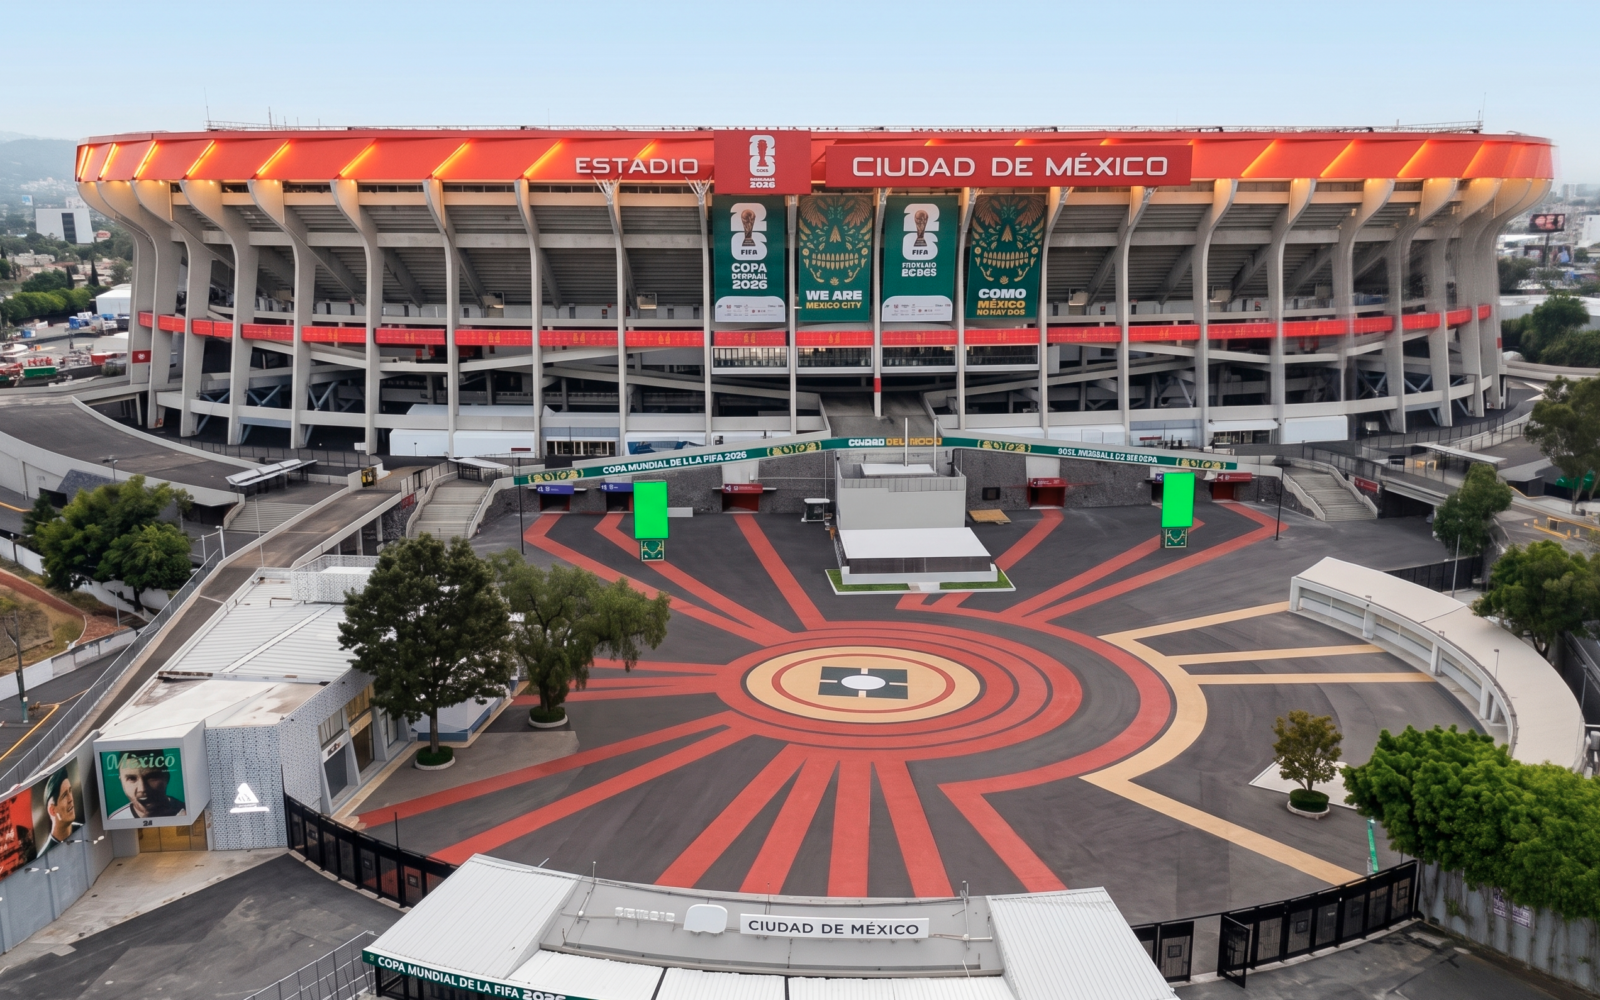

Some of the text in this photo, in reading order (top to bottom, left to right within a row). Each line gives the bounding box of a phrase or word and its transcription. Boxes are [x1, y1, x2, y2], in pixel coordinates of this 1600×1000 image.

[576, 158, 698, 174] ESTADIO
[853, 152, 1168, 176] CIUDAD DE MÉXICO
[732, 263, 767, 272] COPA
[732, 280, 767, 289] 2026
[806, 291, 862, 300] WE ARE
[978, 288, 1026, 299] COMO
[602, 464, 627, 474] COPA
[628, 460, 669, 472] MUNDIAL
[725, 451, 747, 460] 2026
[748, 920, 919, 935] CIUDAD DE MÉXICO
[378, 957, 405, 972] COPA
[408, 965, 457, 985] MUNDIAL
[460, 977, 474, 990] DE
[477, 981, 491, 993] LA
[494, 985, 519, 998] FIFA
